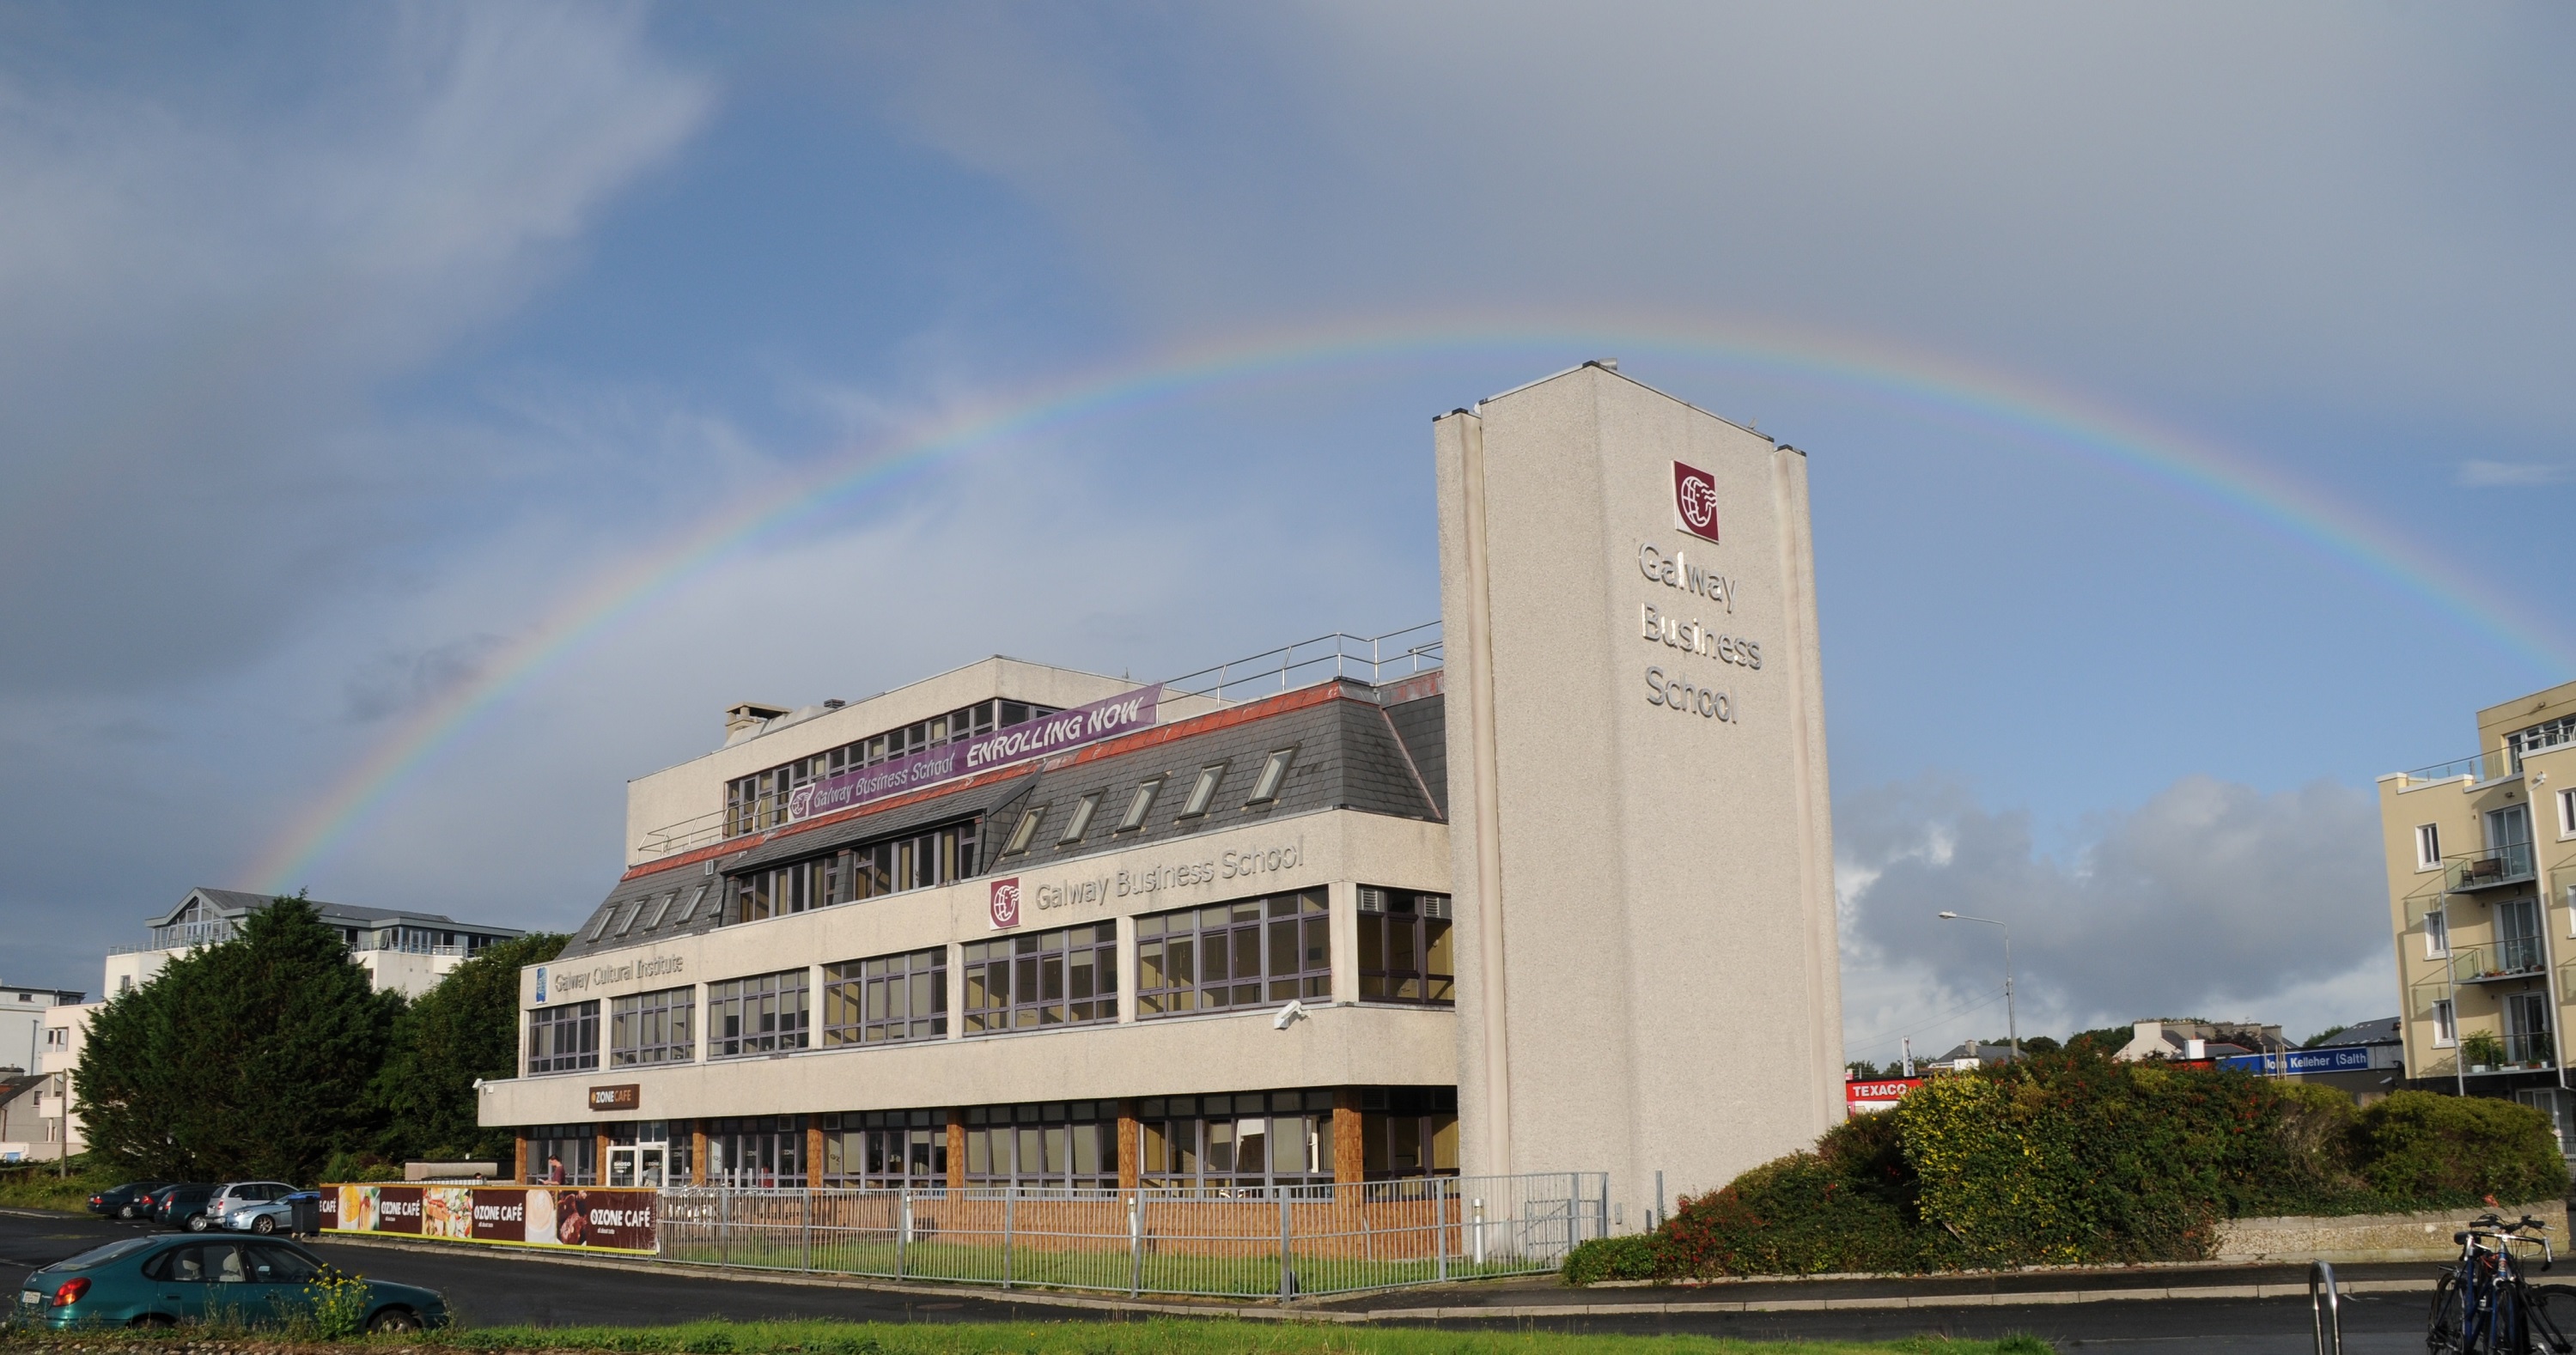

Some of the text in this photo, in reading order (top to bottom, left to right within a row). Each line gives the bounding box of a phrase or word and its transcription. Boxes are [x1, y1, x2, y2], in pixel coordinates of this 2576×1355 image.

[1638, 542, 1738, 614] Galway
[1641, 601, 1762, 671] Business
[1645, 665, 1739, 725] School
[813, 696, 1144, 807] Galway Business School ENROLLING NOW
[1036, 834, 1304, 910] Galway Business School
[555, 970, 591, 992] Galway
[594, 960, 634, 986] Cultural
[636, 953, 684, 979] Institute
[2290, 1055, 2330, 1068] Kelleher
[2335, 1051, 2367, 1066] (Salth
[1853, 1084, 1907, 1097] TEXACO
[381, 1199, 421, 1217] OZONE CAFÉ
[473, 1202, 523, 1222] OZONE CAFÉ
[589, 1206, 651, 1228] OZONE CAFÉ
